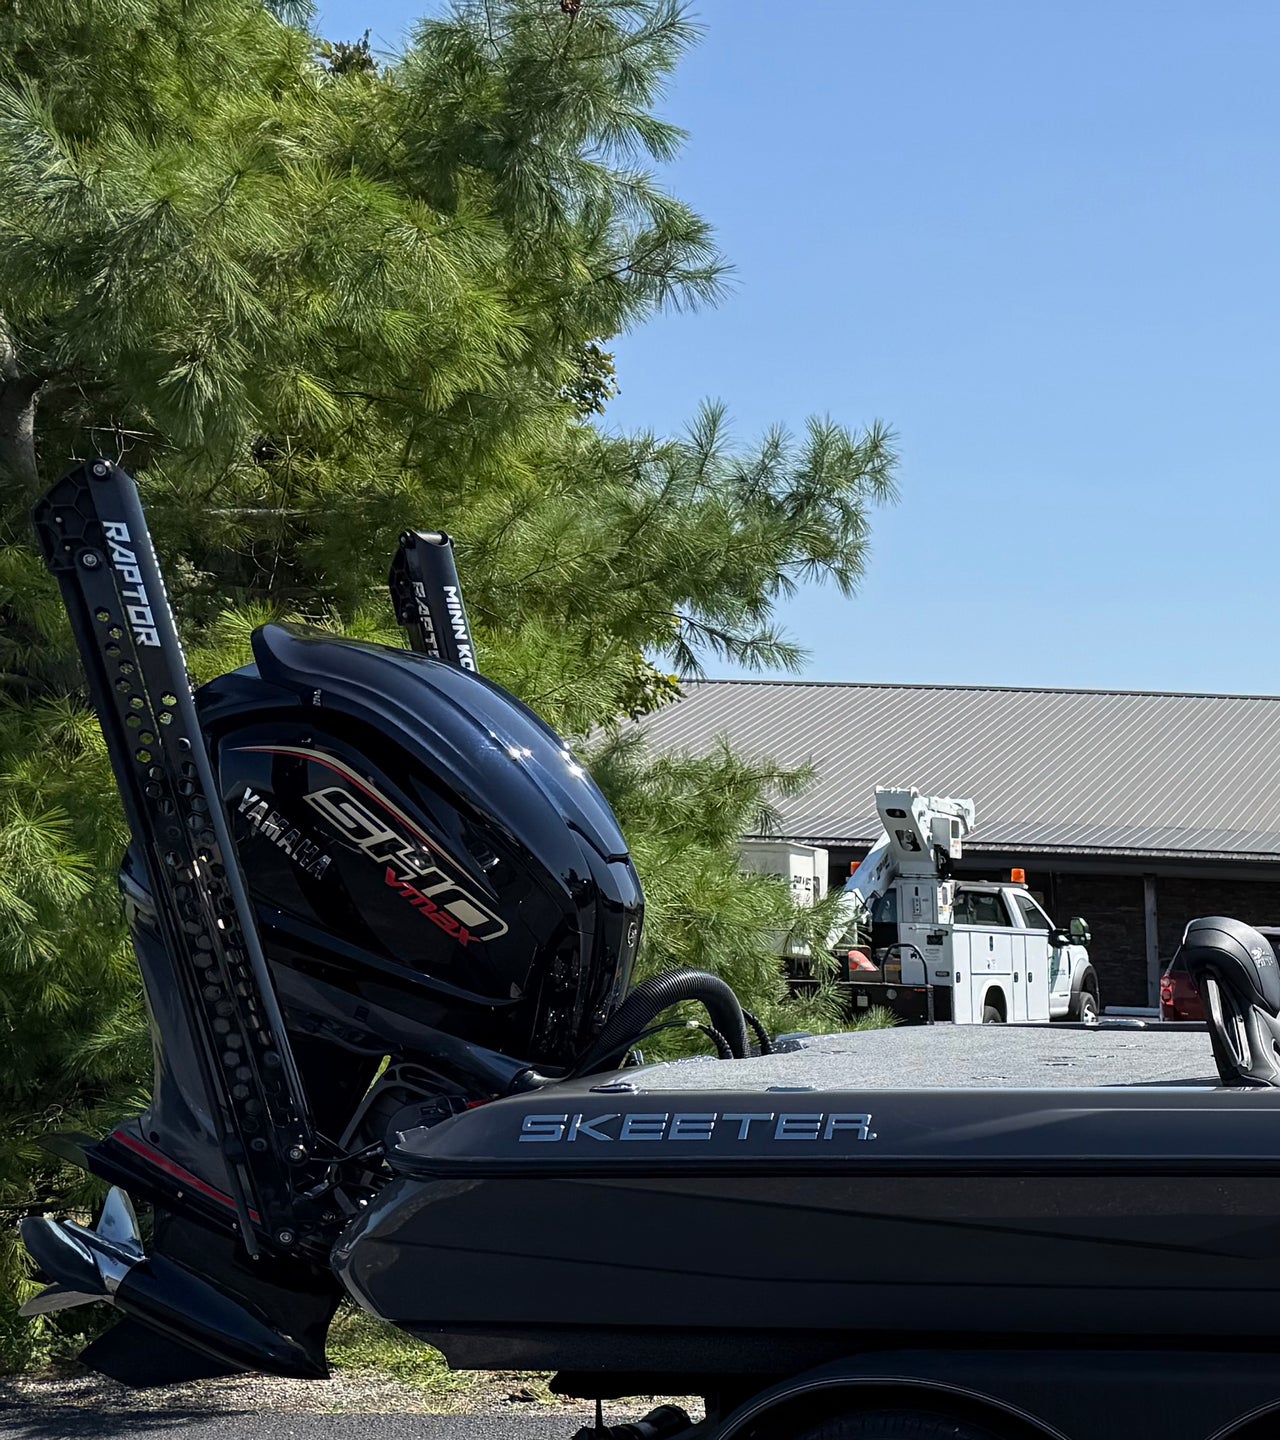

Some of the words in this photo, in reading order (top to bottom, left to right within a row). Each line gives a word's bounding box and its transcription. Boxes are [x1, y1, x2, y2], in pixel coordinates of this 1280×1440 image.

[102, 521, 161, 647] RAPTOR
[443, 585, 468, 640] MINN
[457, 644, 475, 672] KO
[238, 787, 332, 880] YAMAHA
[303, 786, 509, 941] SHO
[518, 1113, 875, 1142] SKEETER
